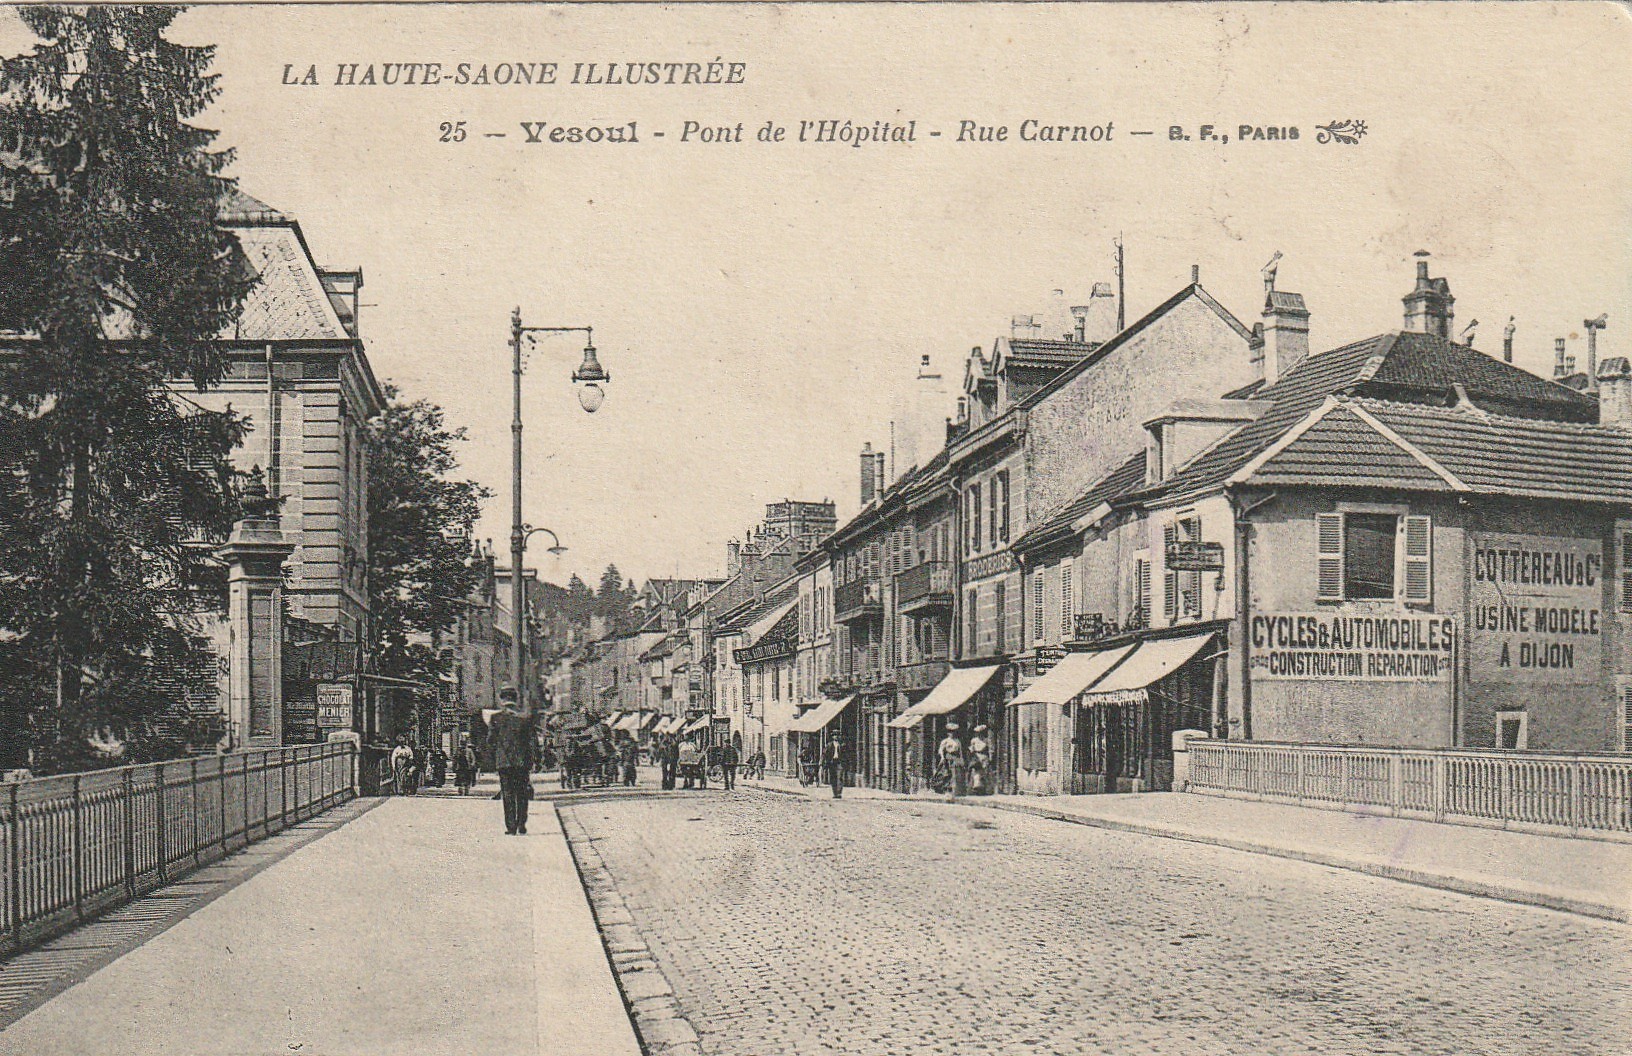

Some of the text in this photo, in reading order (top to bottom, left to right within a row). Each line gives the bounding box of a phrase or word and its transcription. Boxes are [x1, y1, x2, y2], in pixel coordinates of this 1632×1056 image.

[1475, 605, 1529, 632] USINE
[1269, 651, 1363, 676] CONSTRUCTION
[1519, 642, 1574, 669] DIJON
